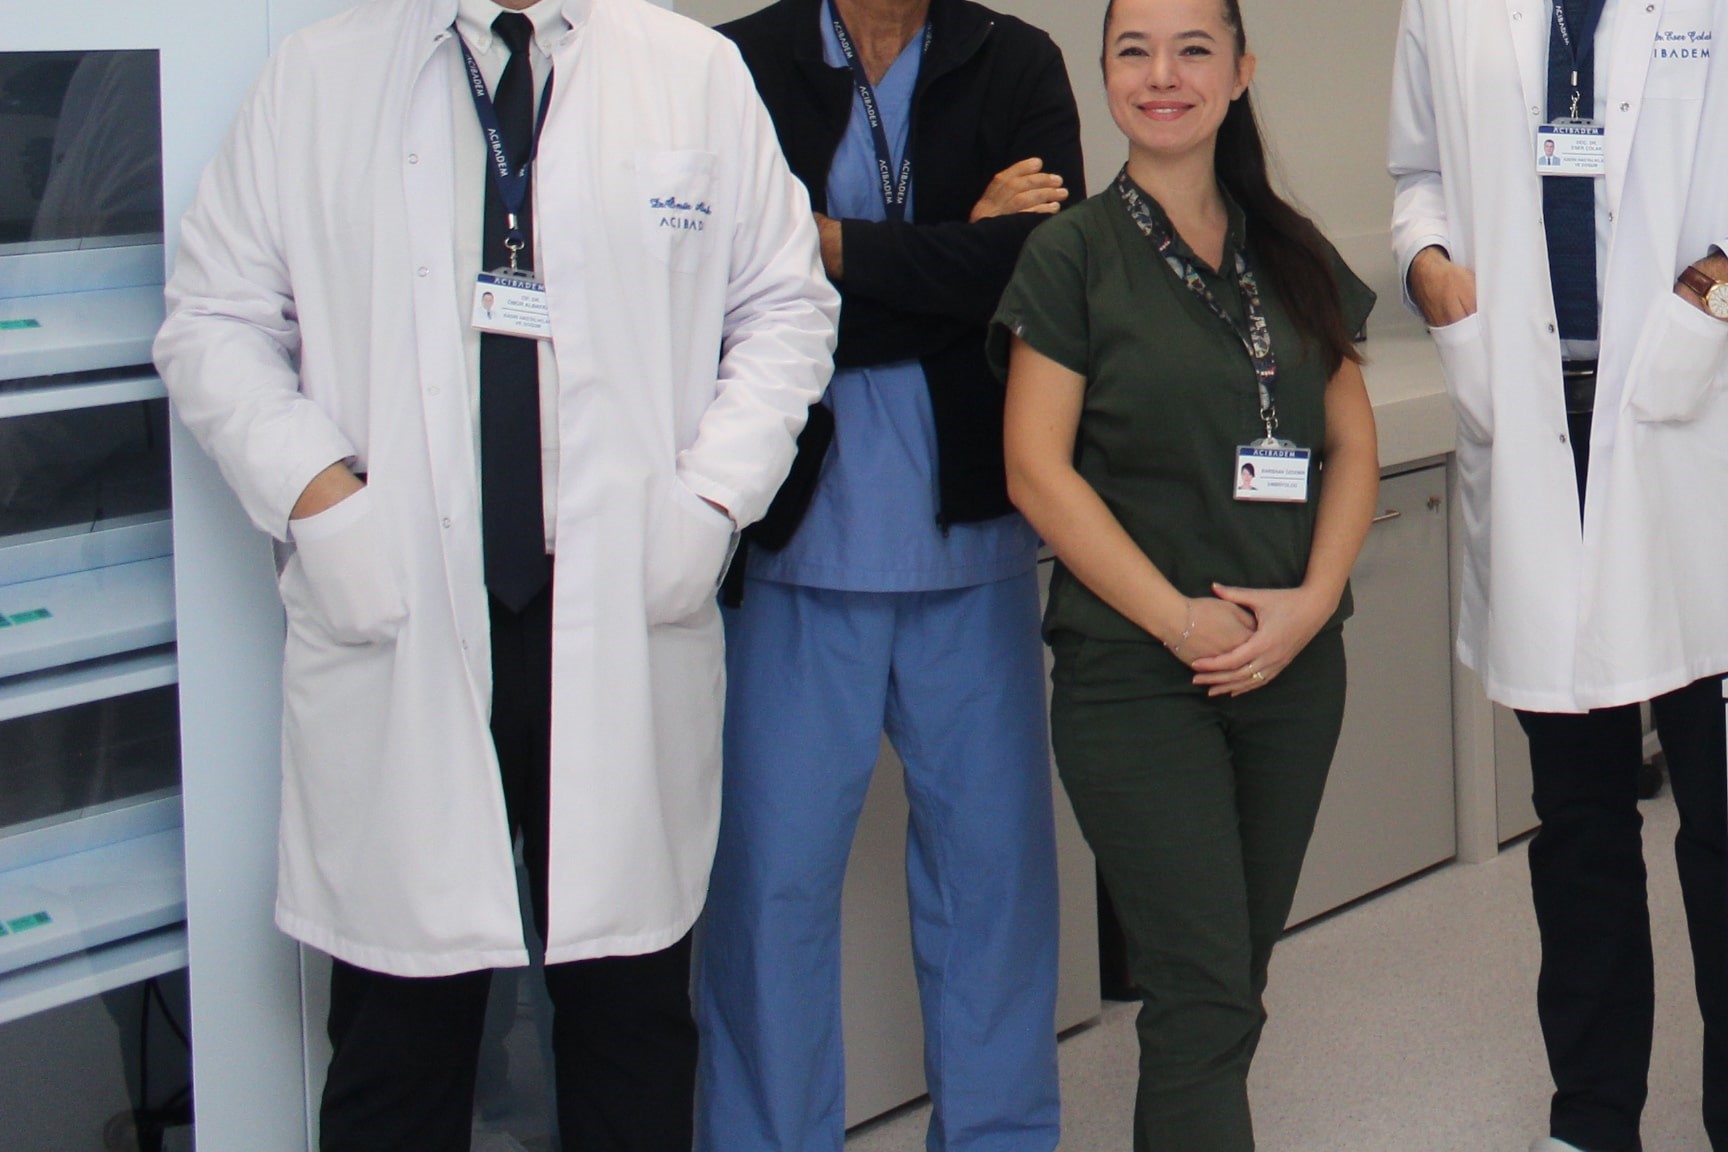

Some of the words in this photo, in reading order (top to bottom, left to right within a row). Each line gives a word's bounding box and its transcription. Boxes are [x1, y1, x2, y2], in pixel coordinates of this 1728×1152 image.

[1556, 5, 1570, 46] ACIBADEM
[859, 86, 878, 128] ACIBADEM
[488, 128, 509, 178] ACIBADEM
[879, 159, 894, 204] ACIBADEM
[896, 160, 910, 204] ACIBADEM
[494, 278, 545, 290] ACIBADEM
